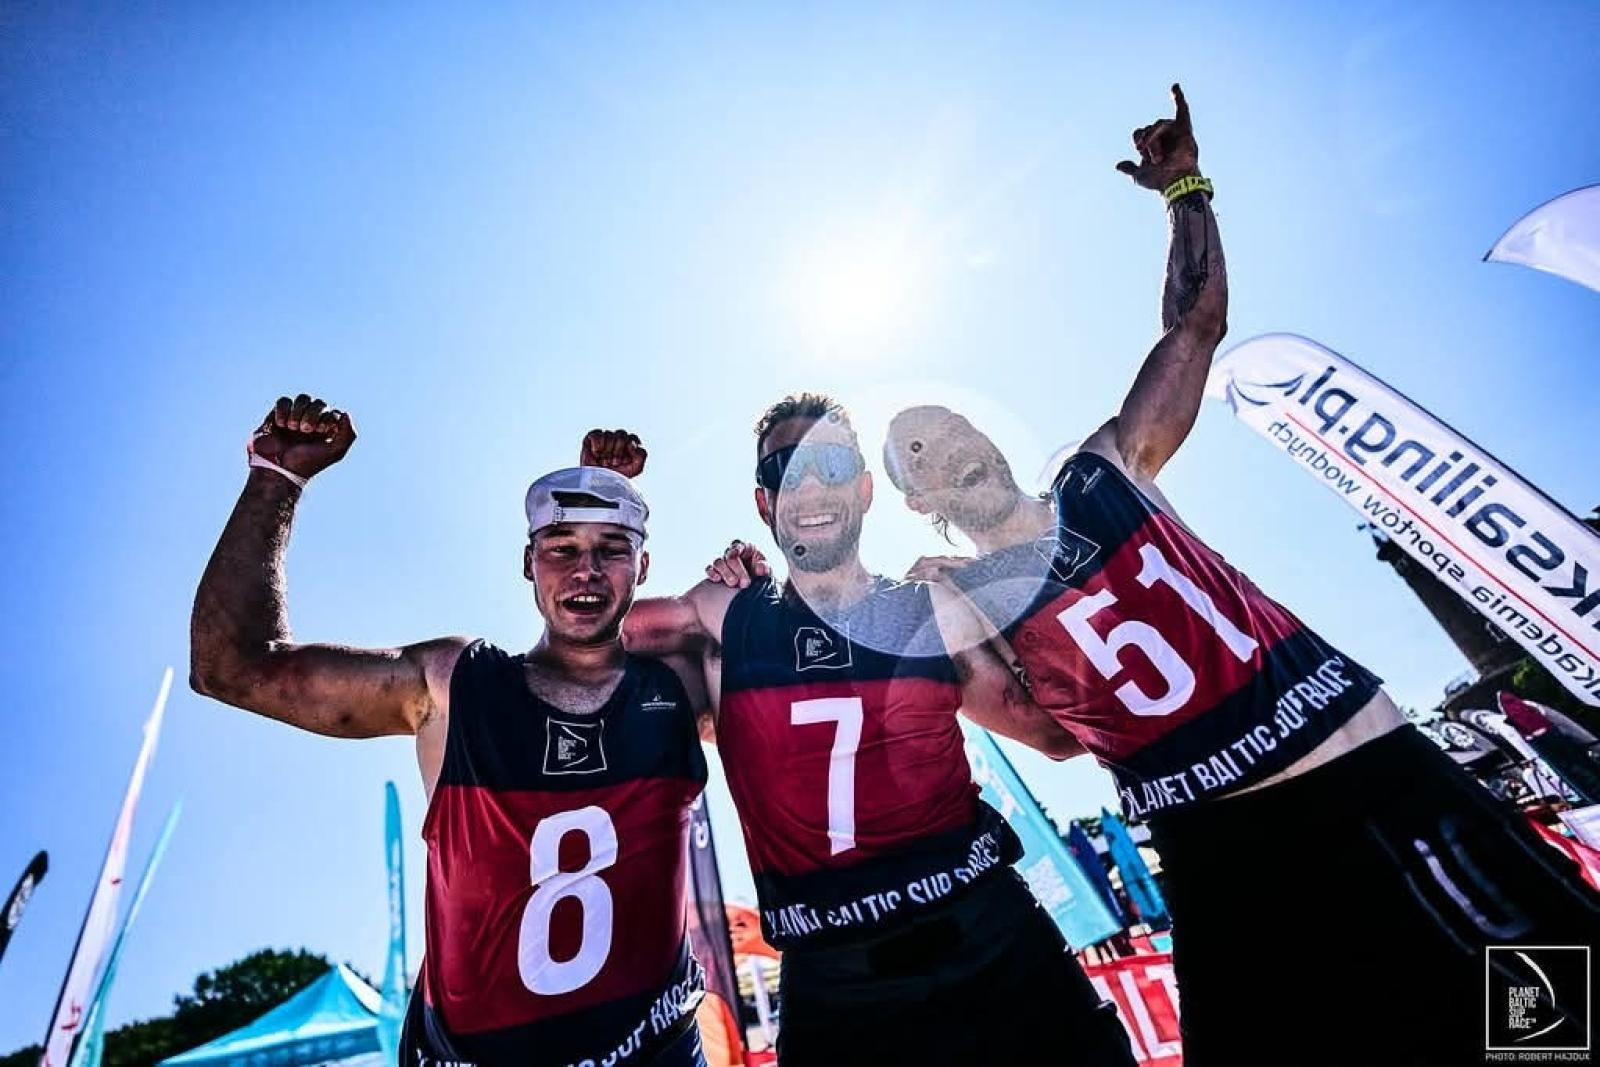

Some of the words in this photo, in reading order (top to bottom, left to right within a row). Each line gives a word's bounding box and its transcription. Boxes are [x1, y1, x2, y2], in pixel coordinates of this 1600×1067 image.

[1056, 542, 1260, 717] 51
[791, 697, 864, 857] 7
[517, 805, 619, 996] 8
